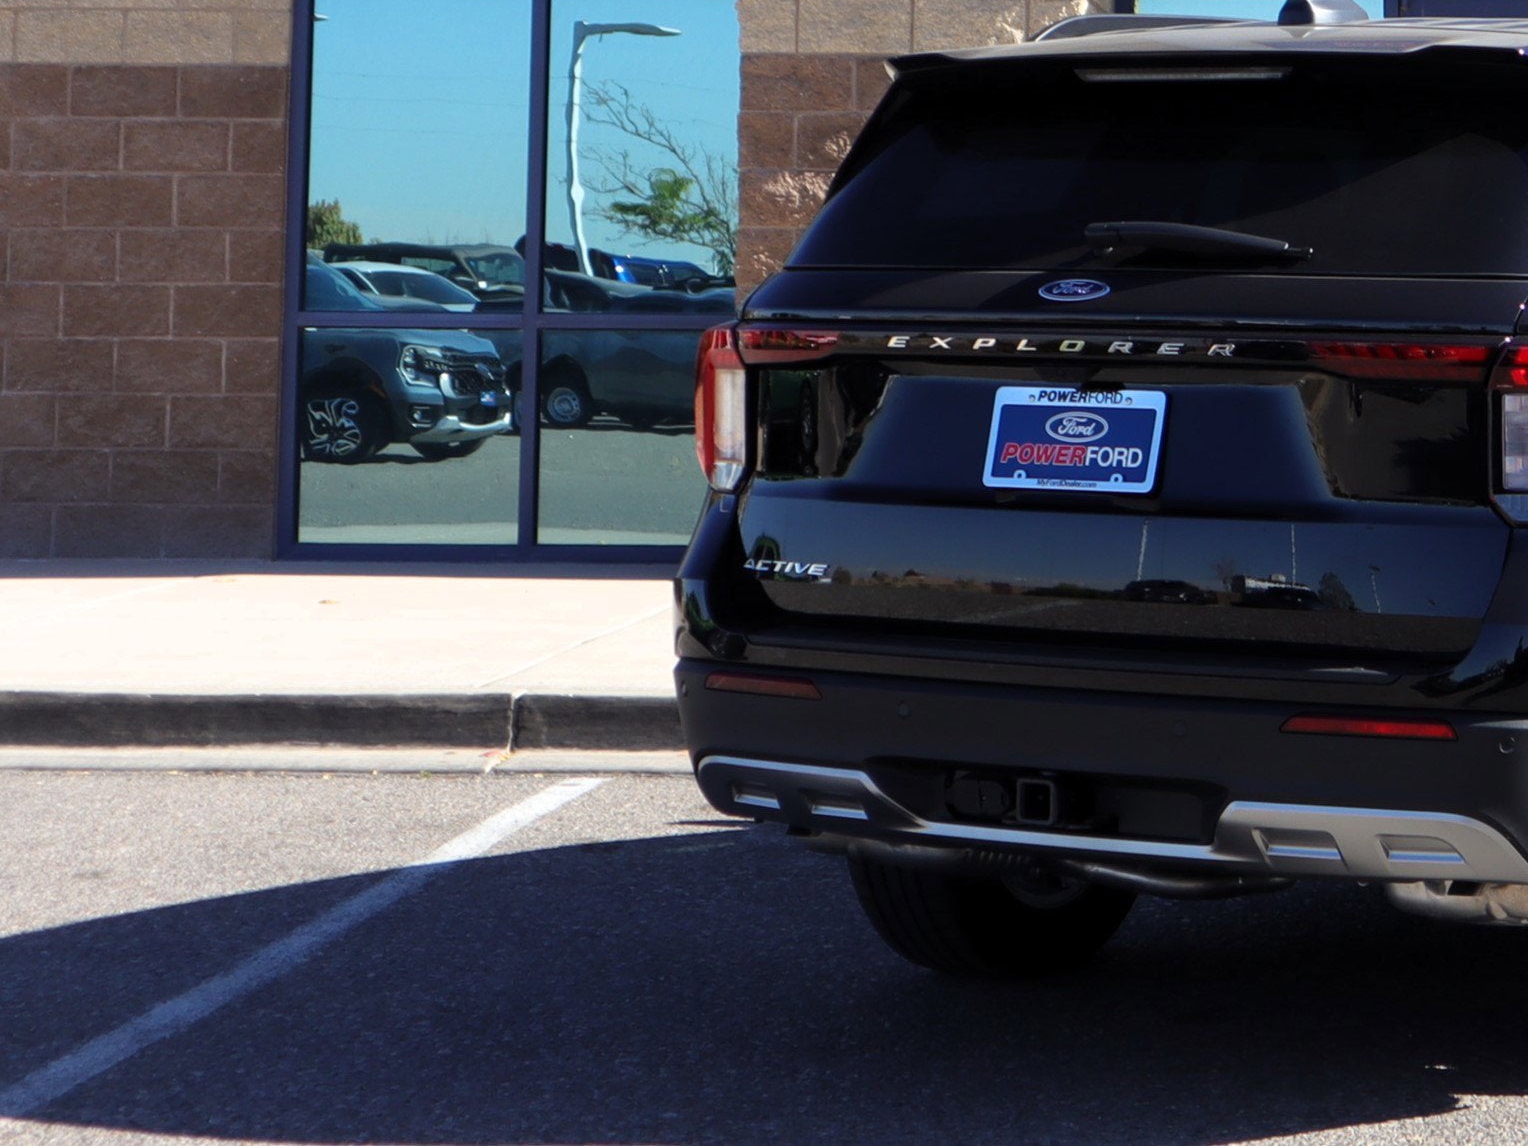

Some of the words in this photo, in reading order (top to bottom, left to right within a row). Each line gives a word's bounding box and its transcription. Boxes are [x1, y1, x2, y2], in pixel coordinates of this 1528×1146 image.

[1052, 280, 1094, 295] Ford
[887, 335, 1236, 357] EXPLORER
[1037, 389, 1124, 404] POWERFORD
[1057, 417, 1097, 436] Ford
[1000, 442, 1143, 468] POWERFORD
[743, 558, 829, 576] ACTIVE
